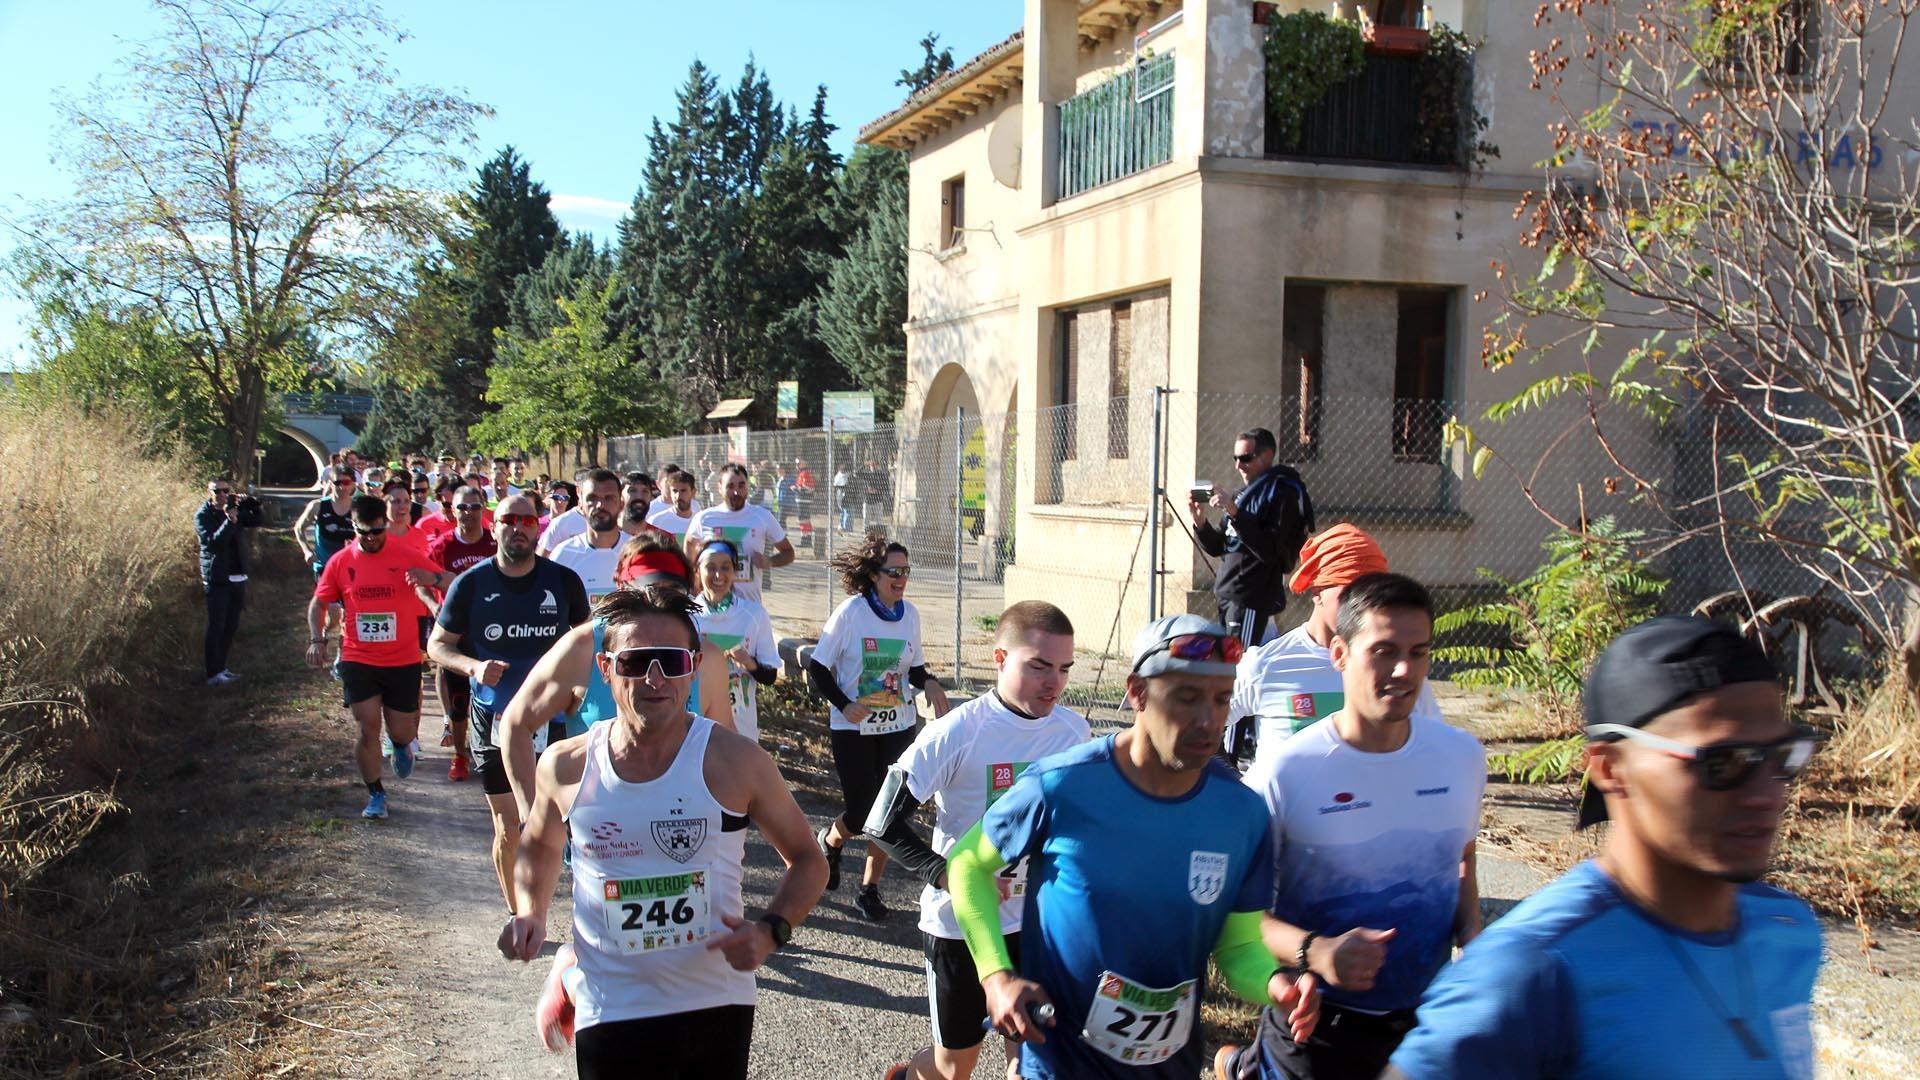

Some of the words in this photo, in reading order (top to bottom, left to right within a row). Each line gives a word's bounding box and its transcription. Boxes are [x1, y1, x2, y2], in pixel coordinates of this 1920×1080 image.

[362, 622, 390, 633] 234
[507, 624, 556, 637] Chiruca
[1295, 697, 1312, 709] 28
[867, 709, 897, 724] 290
[995, 767, 1011, 780] 28
[606, 884, 618, 894] 28
[620, 880, 643, 896] VIA
[646, 875, 689, 894] VERDE
[621, 897, 694, 931] 246
[1106, 1006, 1179, 1041] 271
